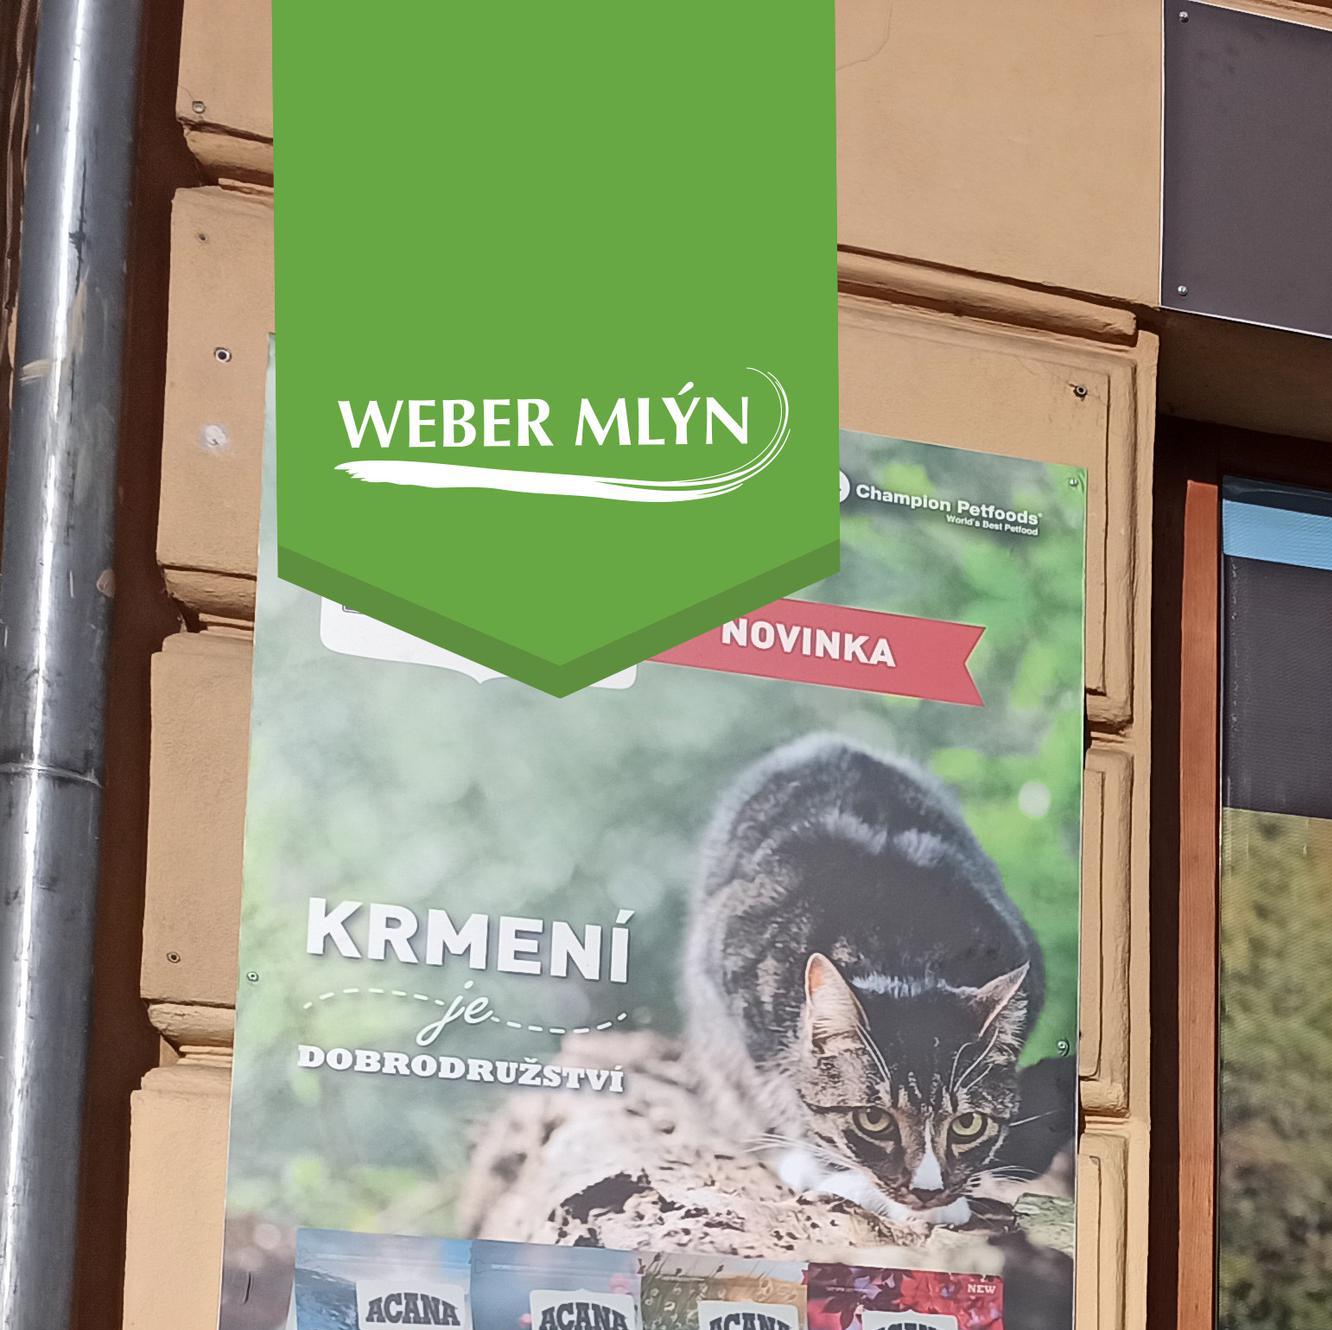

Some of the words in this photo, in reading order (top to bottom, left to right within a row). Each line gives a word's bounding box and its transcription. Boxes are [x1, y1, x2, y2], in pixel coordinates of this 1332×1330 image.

[856, 484, 951, 512] Champion
[946, 514, 980, 528] World's
[982, 519, 1003, 532] Best
[1004, 522, 1039, 537] Petfood
[721, 618, 896, 668] NOVINKA
[306, 897, 635, 983] KRMENÍ
[415, 980, 493, 1047] je
[297, 1044, 625, 1093] DOBRODRUŽSTVÍ
[365, 1292, 461, 1326] ACANA
[967, 1283, 996, 1294] NEW
